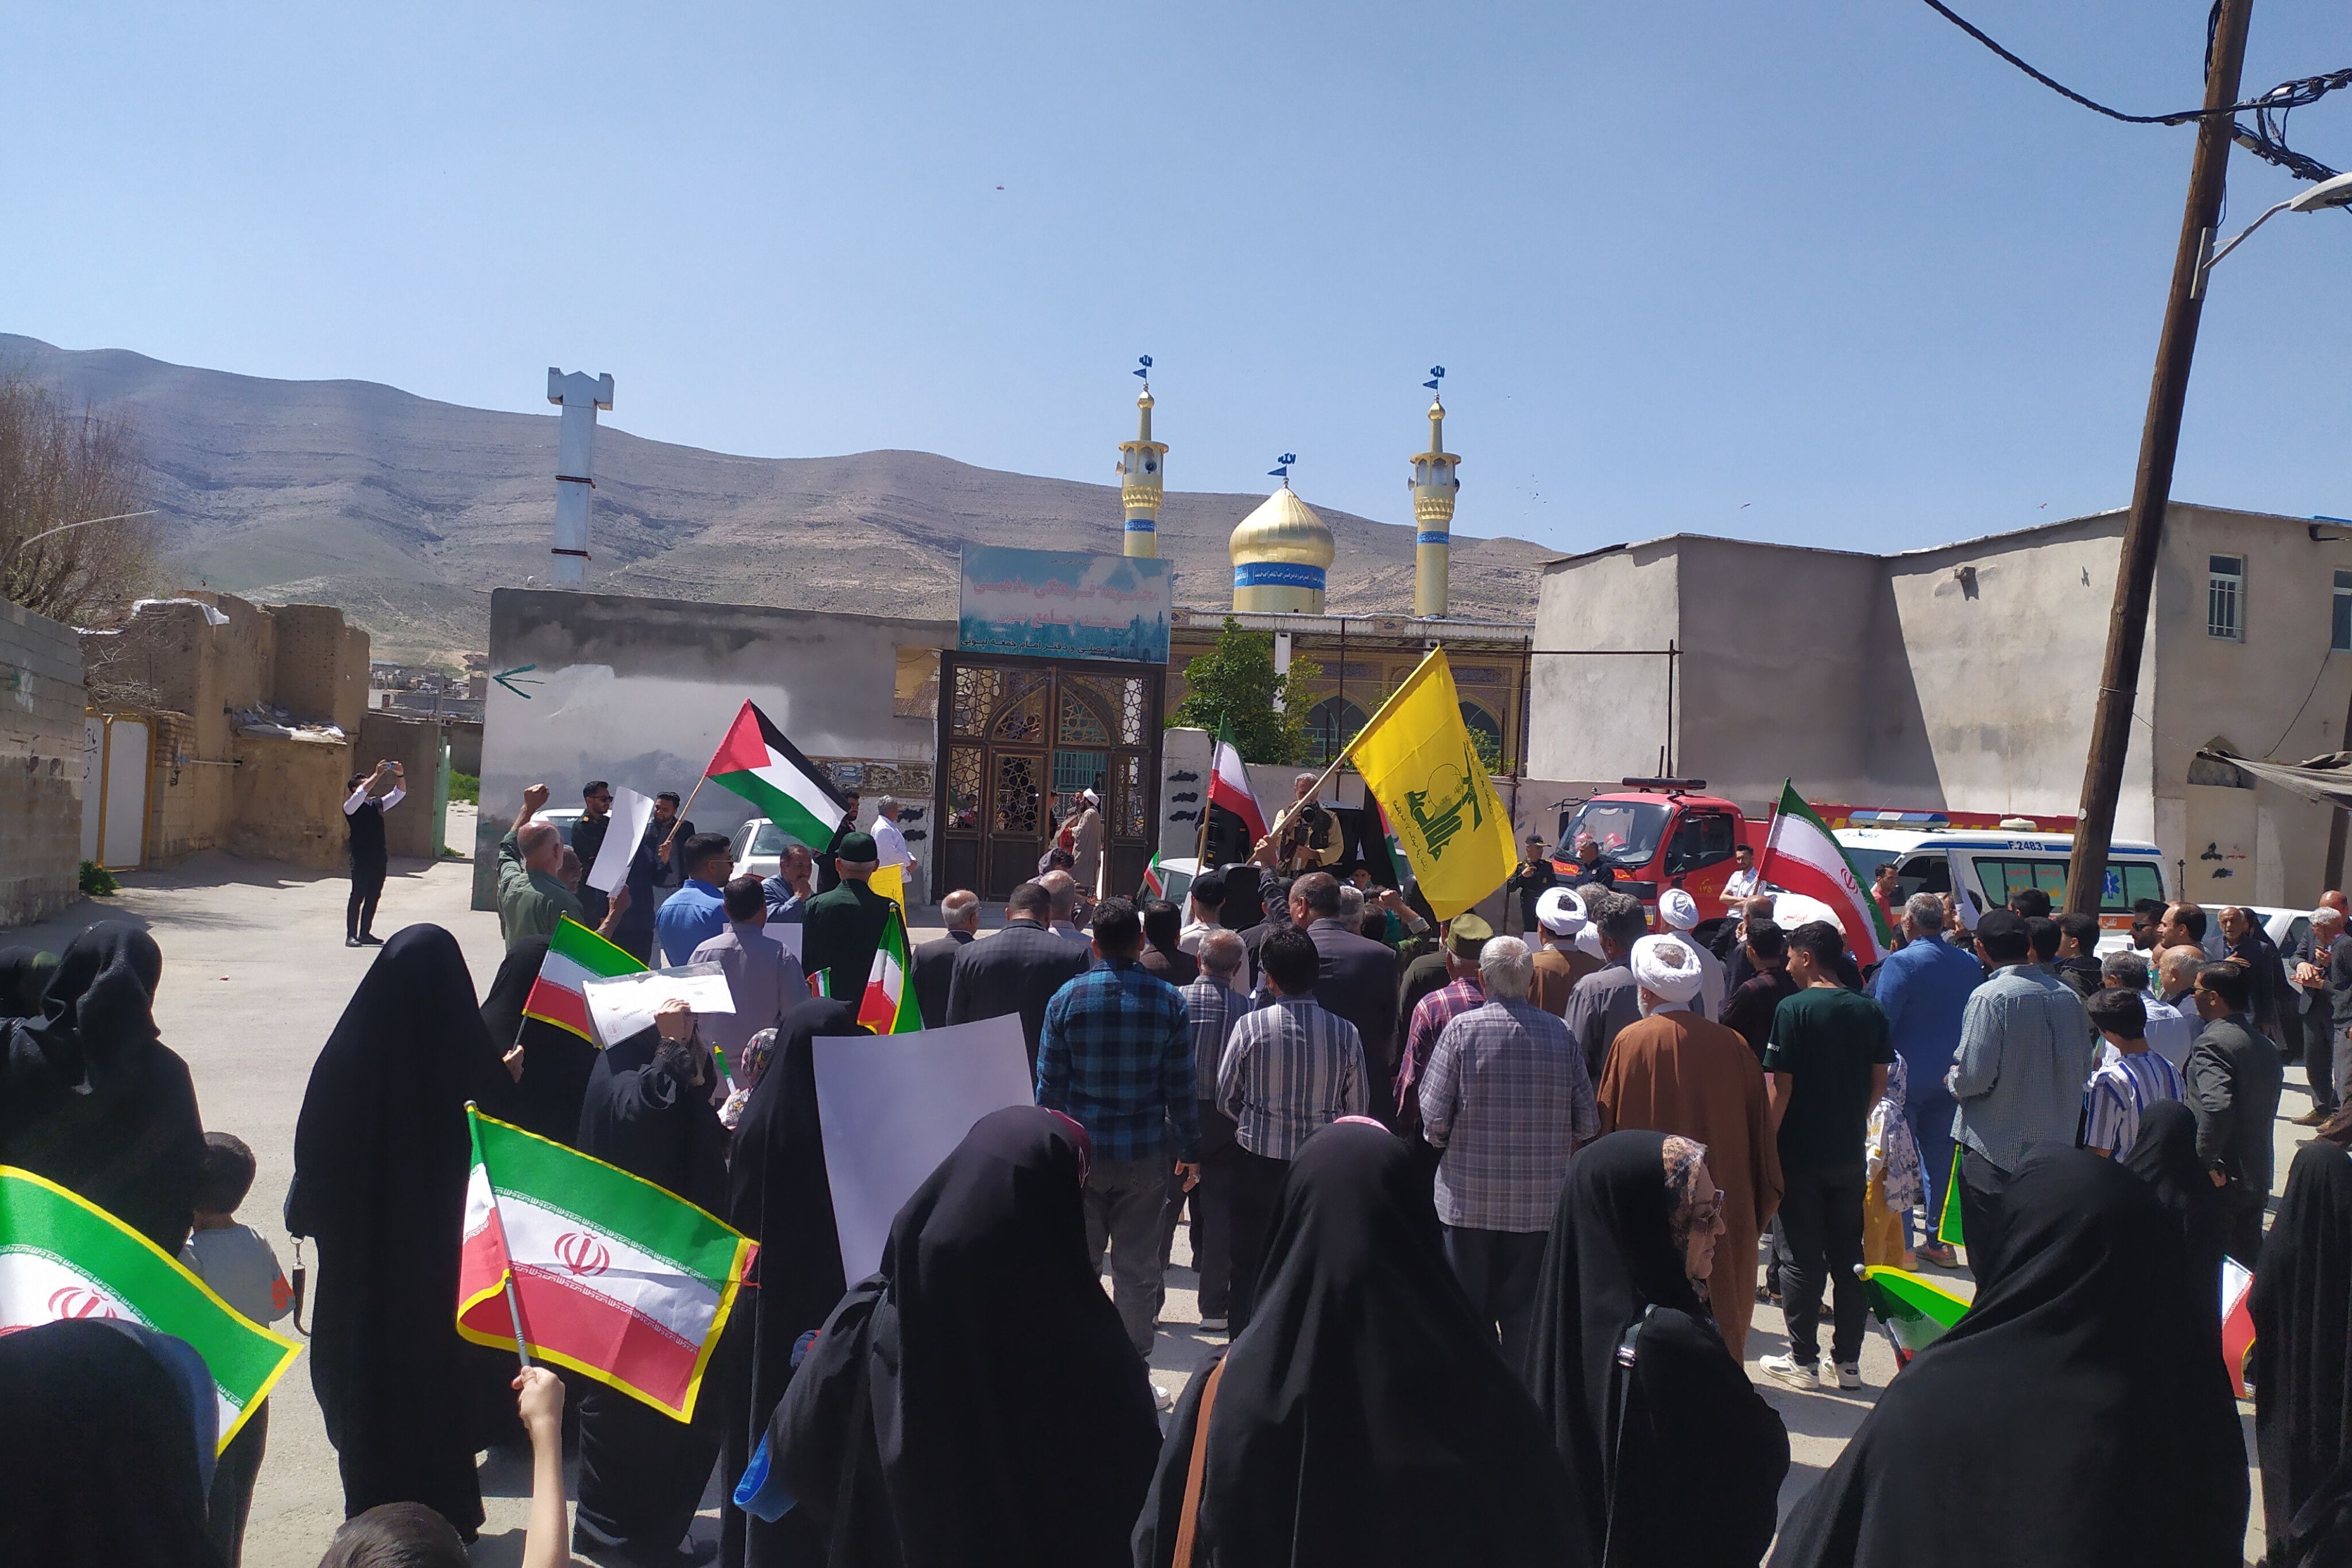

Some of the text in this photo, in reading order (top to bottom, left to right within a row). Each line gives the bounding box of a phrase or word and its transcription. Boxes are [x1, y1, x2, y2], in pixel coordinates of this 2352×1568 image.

[1278, 452, 1296, 464] الله
[973, 574, 1159, 605] مجموعه فرهنگی مذهبی
[1031, 608, 1076, 629] جامع
[1080, 614, 1130, 632] مسجد
[991, 640, 1016, 648] جمعه
[1020, 641, 1040, 651] امام
[1042, 643, 1067, 652] دفتر
[1077, 644, 1107, 654] مصلی
